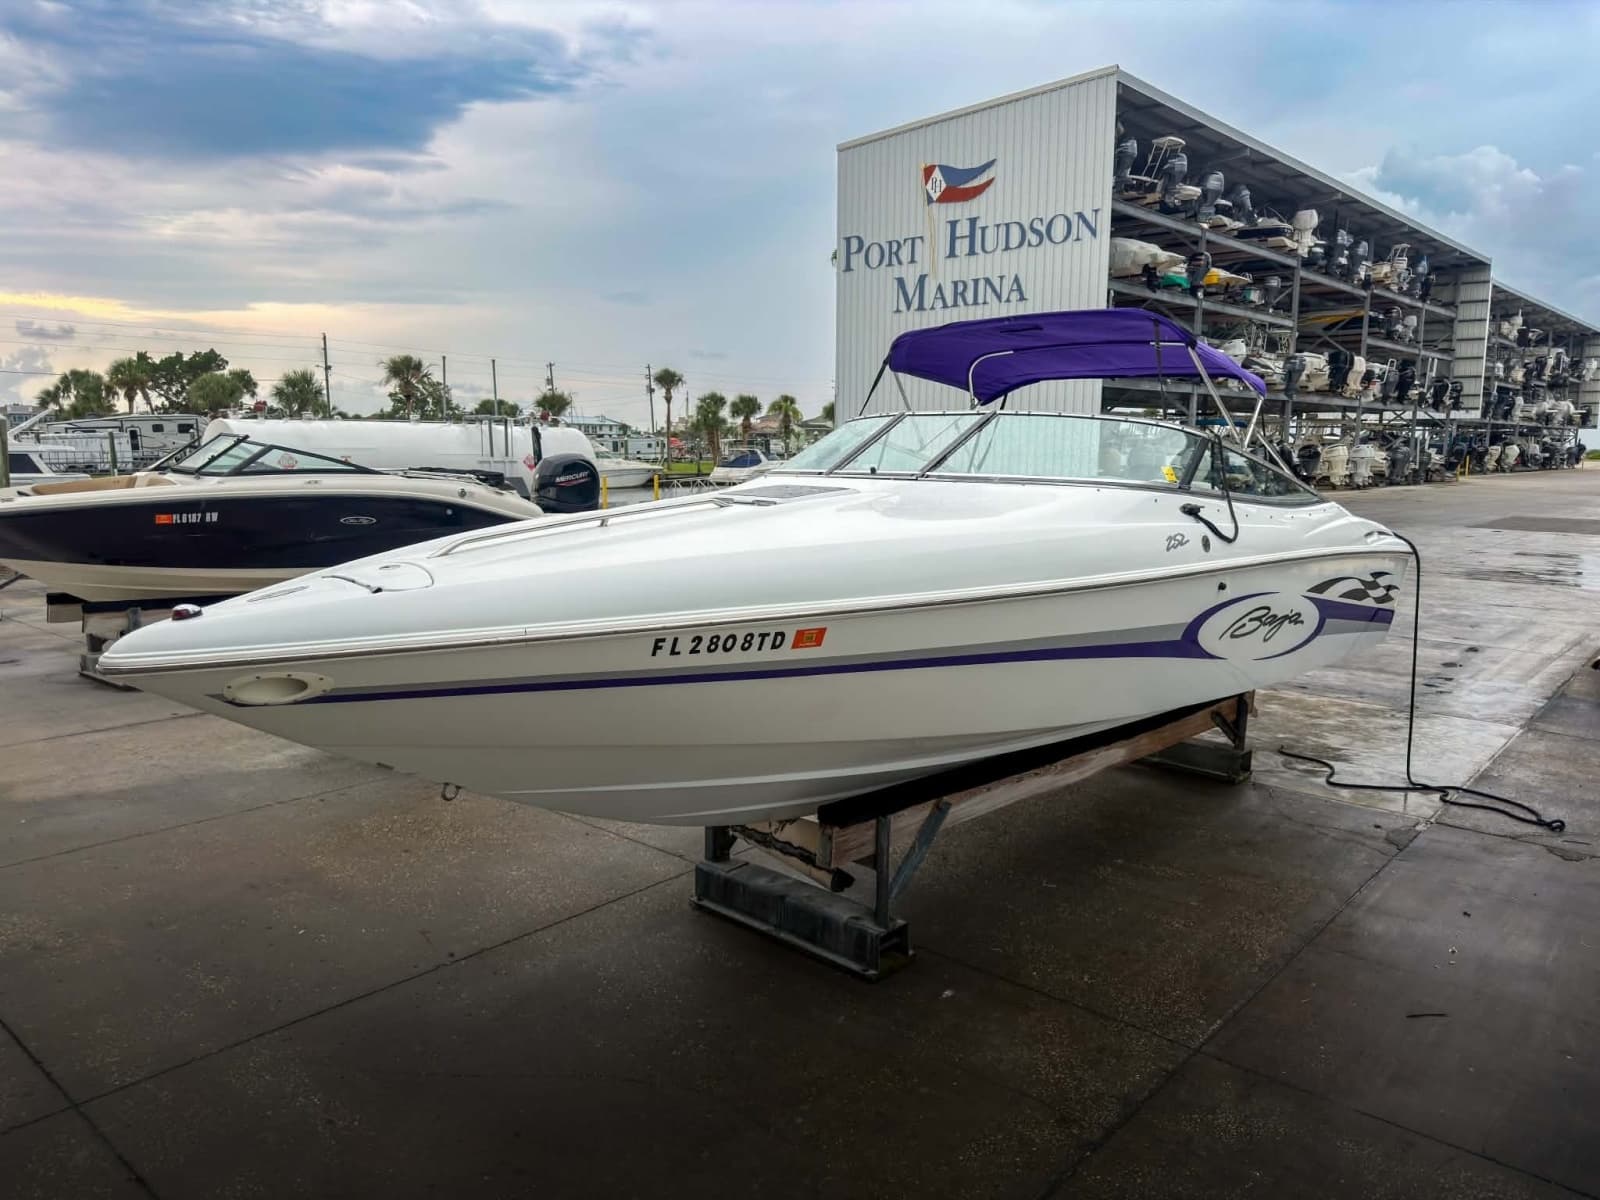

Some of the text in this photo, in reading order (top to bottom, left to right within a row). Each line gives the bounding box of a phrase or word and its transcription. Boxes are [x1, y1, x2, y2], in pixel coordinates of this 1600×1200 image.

[842, 208, 1101, 272] PORT HUDSON
[893, 273, 1028, 313] MARINA
[1219, 606, 1304, 643] Baja
